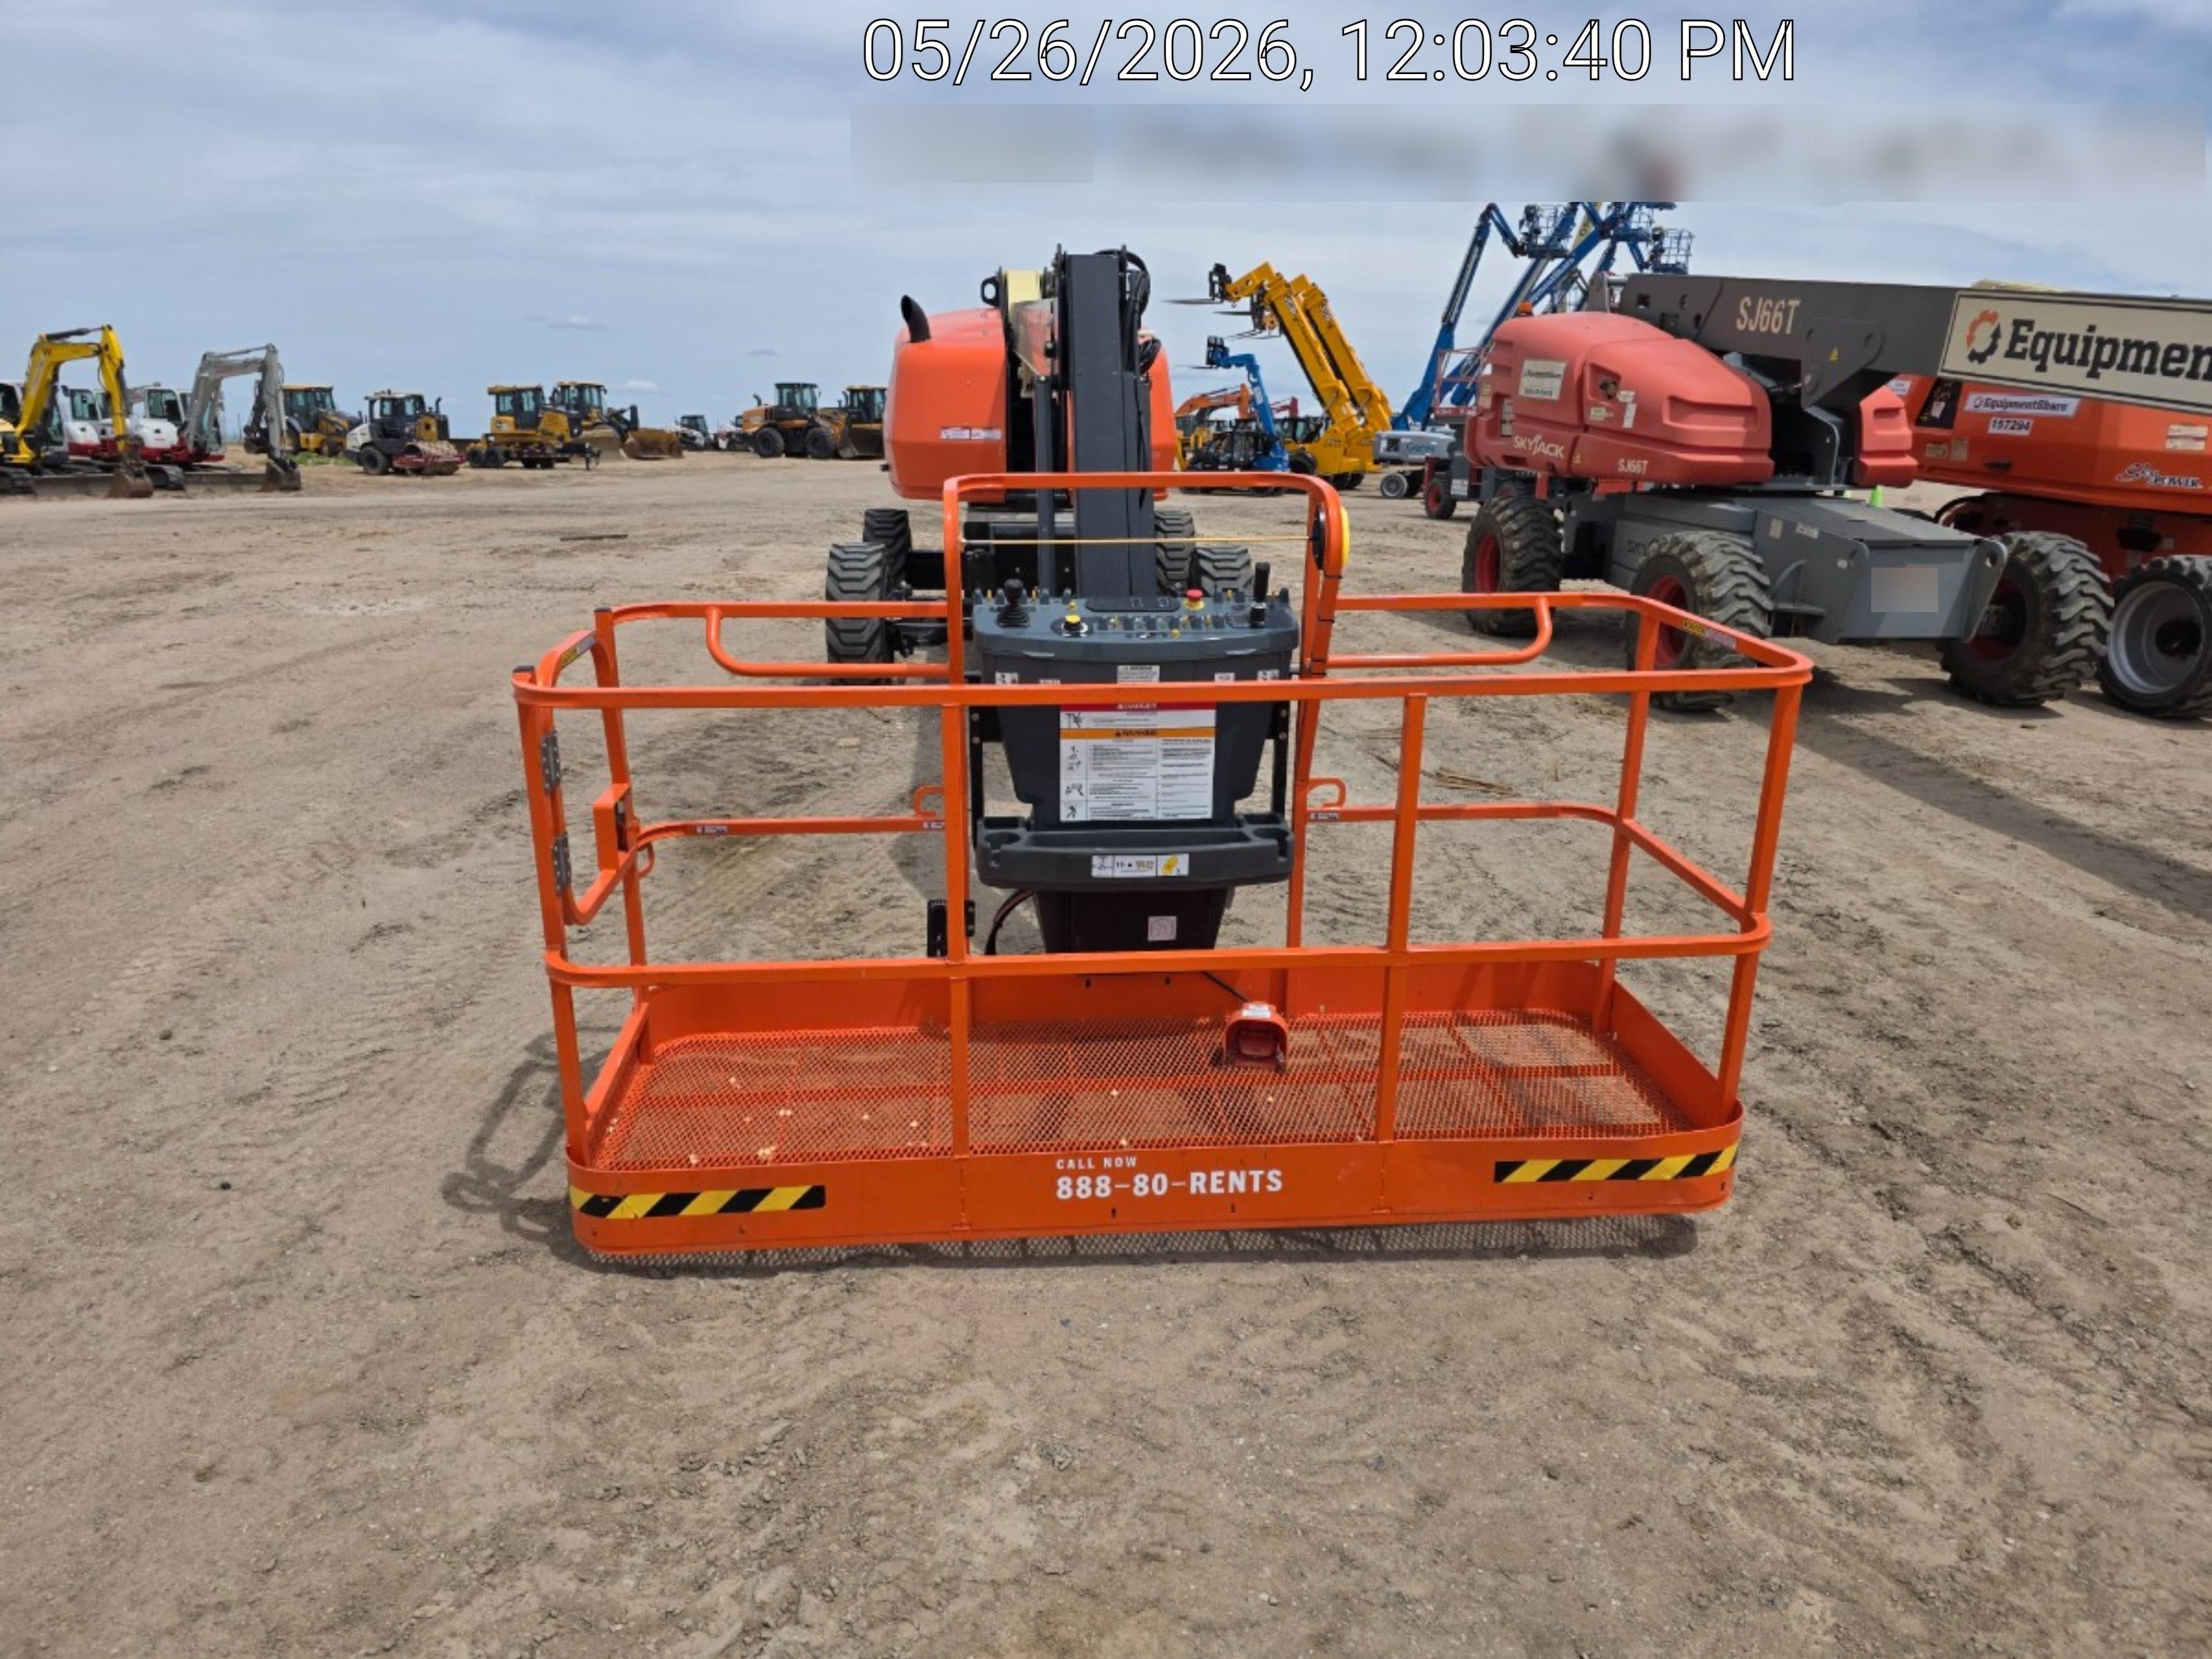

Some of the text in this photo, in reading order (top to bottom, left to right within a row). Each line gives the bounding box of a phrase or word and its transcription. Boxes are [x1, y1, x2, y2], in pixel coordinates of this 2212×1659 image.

[1736, 296, 1801, 334] SJ66T
[2004, 319, 2212, 381] Equipmen
[1984, 397, 2067, 412] EquipmentShare
[1991, 419, 2030, 431] 157294
[1513, 434, 1564, 458] SKYJACK
[1618, 458, 1648, 474] SJ66T
[1056, 1157, 1137, 1169] CALL NOW
[1056, 1169, 1283, 1199] 888-80-RENTS
